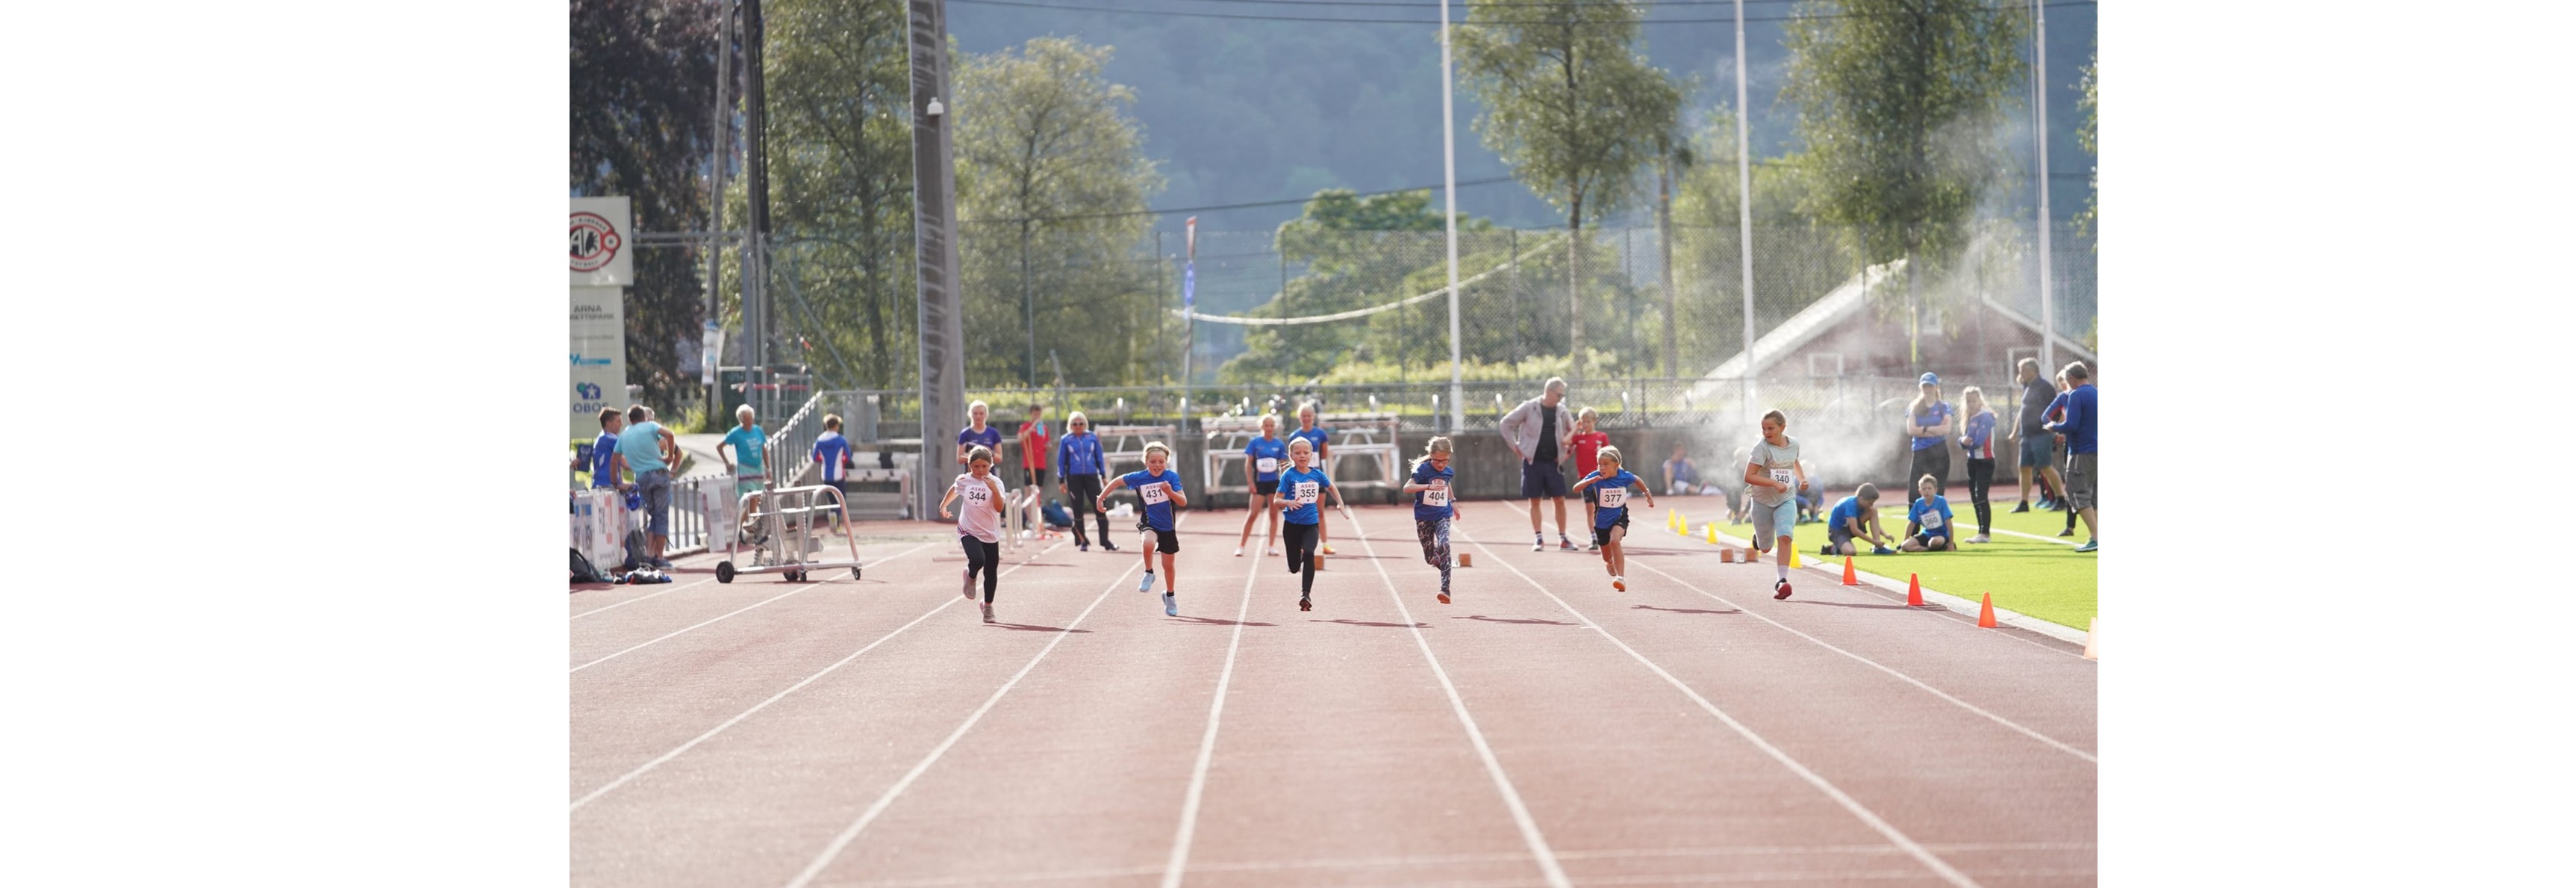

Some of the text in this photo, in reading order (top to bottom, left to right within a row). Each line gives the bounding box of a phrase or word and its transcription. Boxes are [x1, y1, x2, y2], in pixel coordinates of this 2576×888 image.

[574, 305, 602, 313] ARNA
[1775, 475, 1789, 484] 340
[969, 491, 986, 501] 344
[1146, 489, 1162, 498] 431
[1300, 489, 1316, 498] 355
[1429, 492, 1444, 500] 404
[1604, 494, 1622, 503] 377
